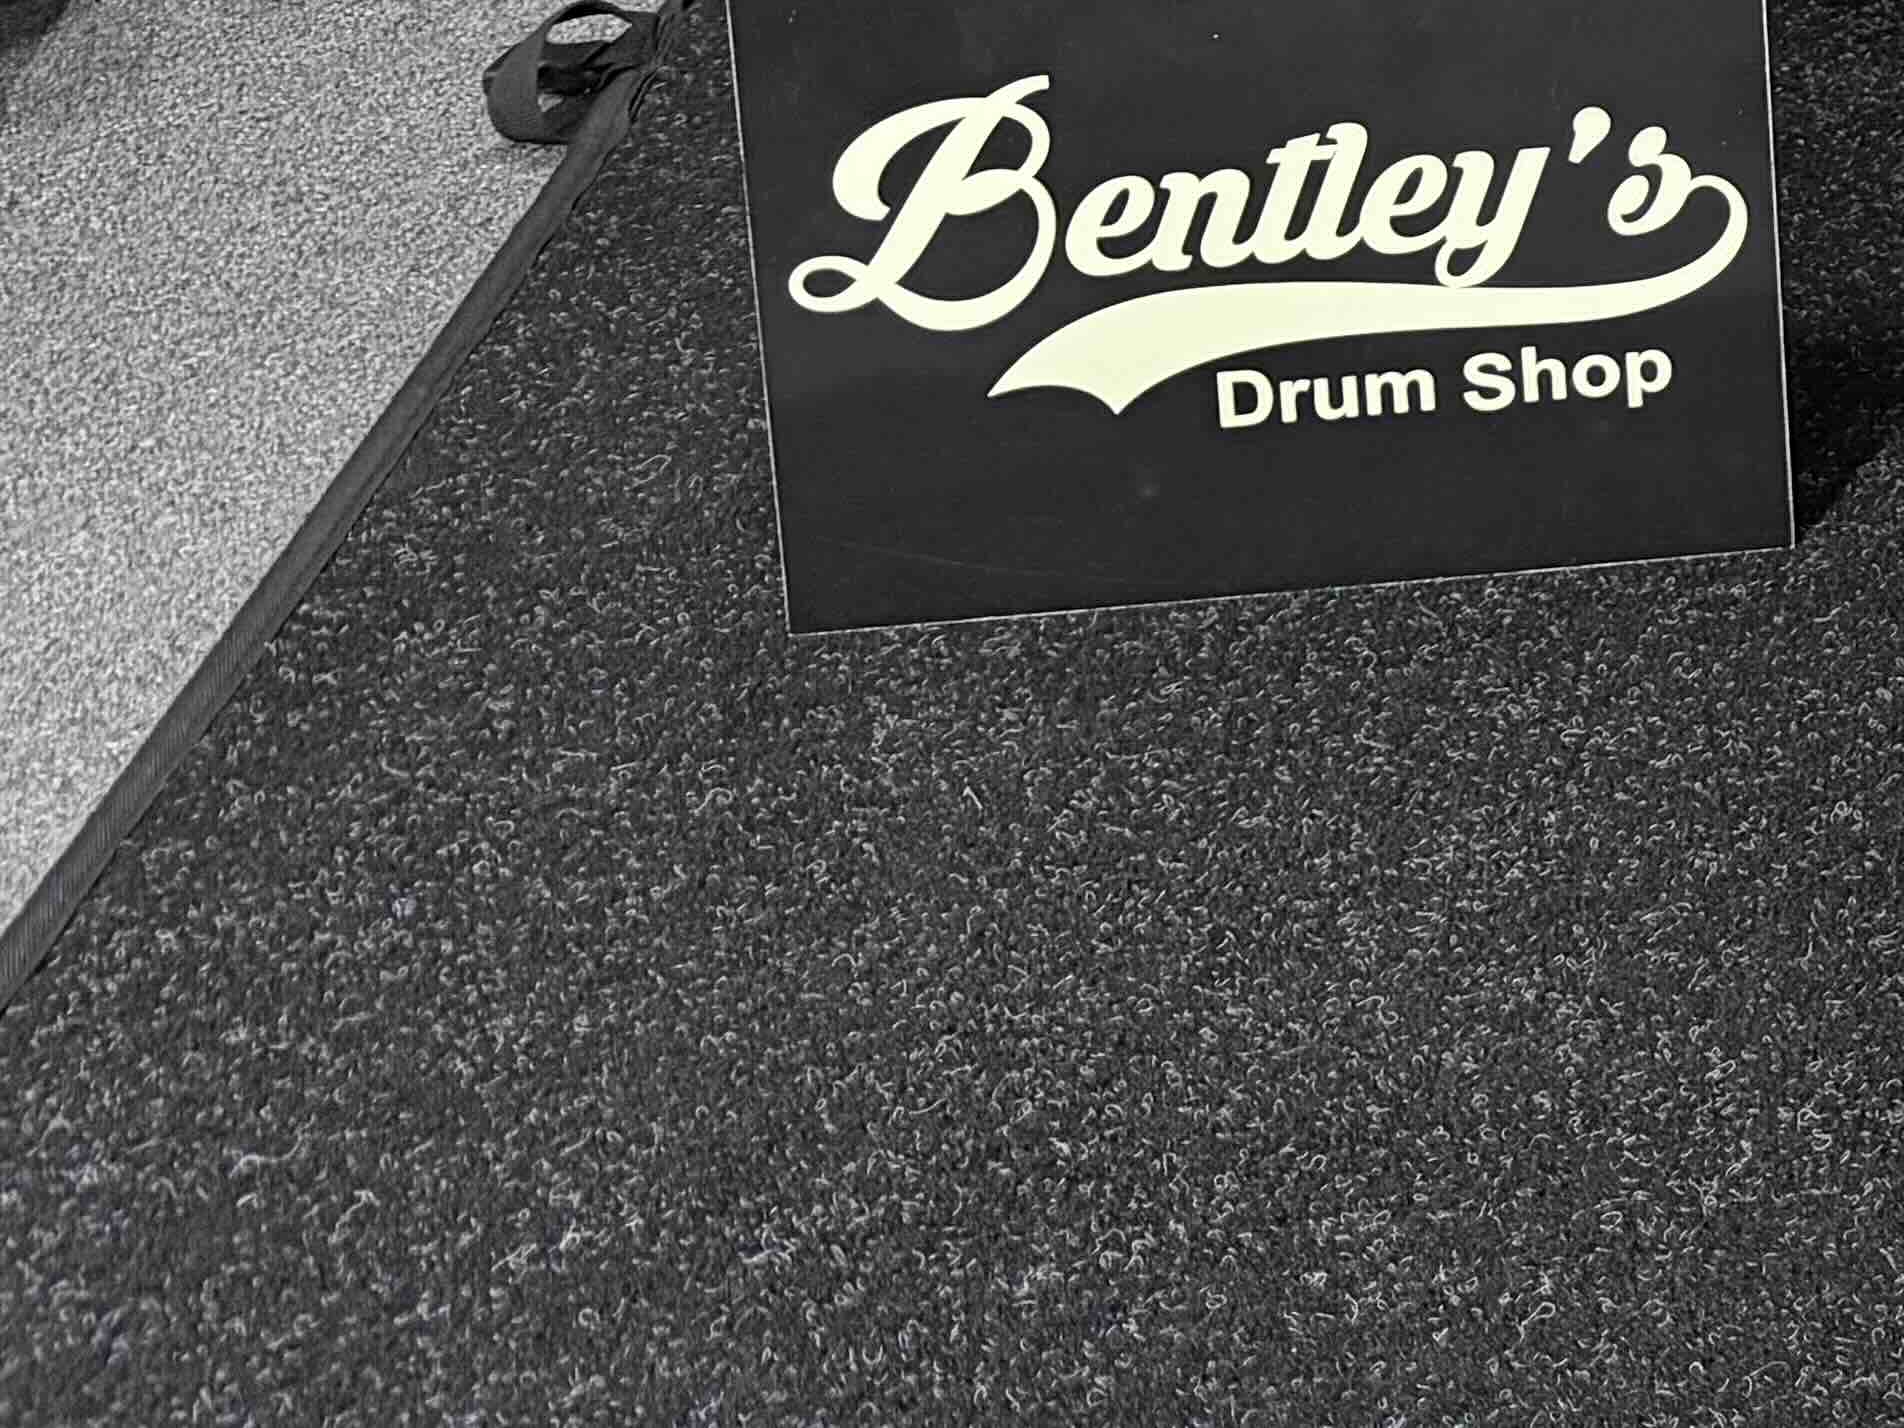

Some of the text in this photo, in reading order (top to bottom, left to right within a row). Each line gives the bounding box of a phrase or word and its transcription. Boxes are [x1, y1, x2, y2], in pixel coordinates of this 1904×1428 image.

[788, 74, 1697, 331] Bentley's
[1215, 343, 1674, 429] Drum Shop
